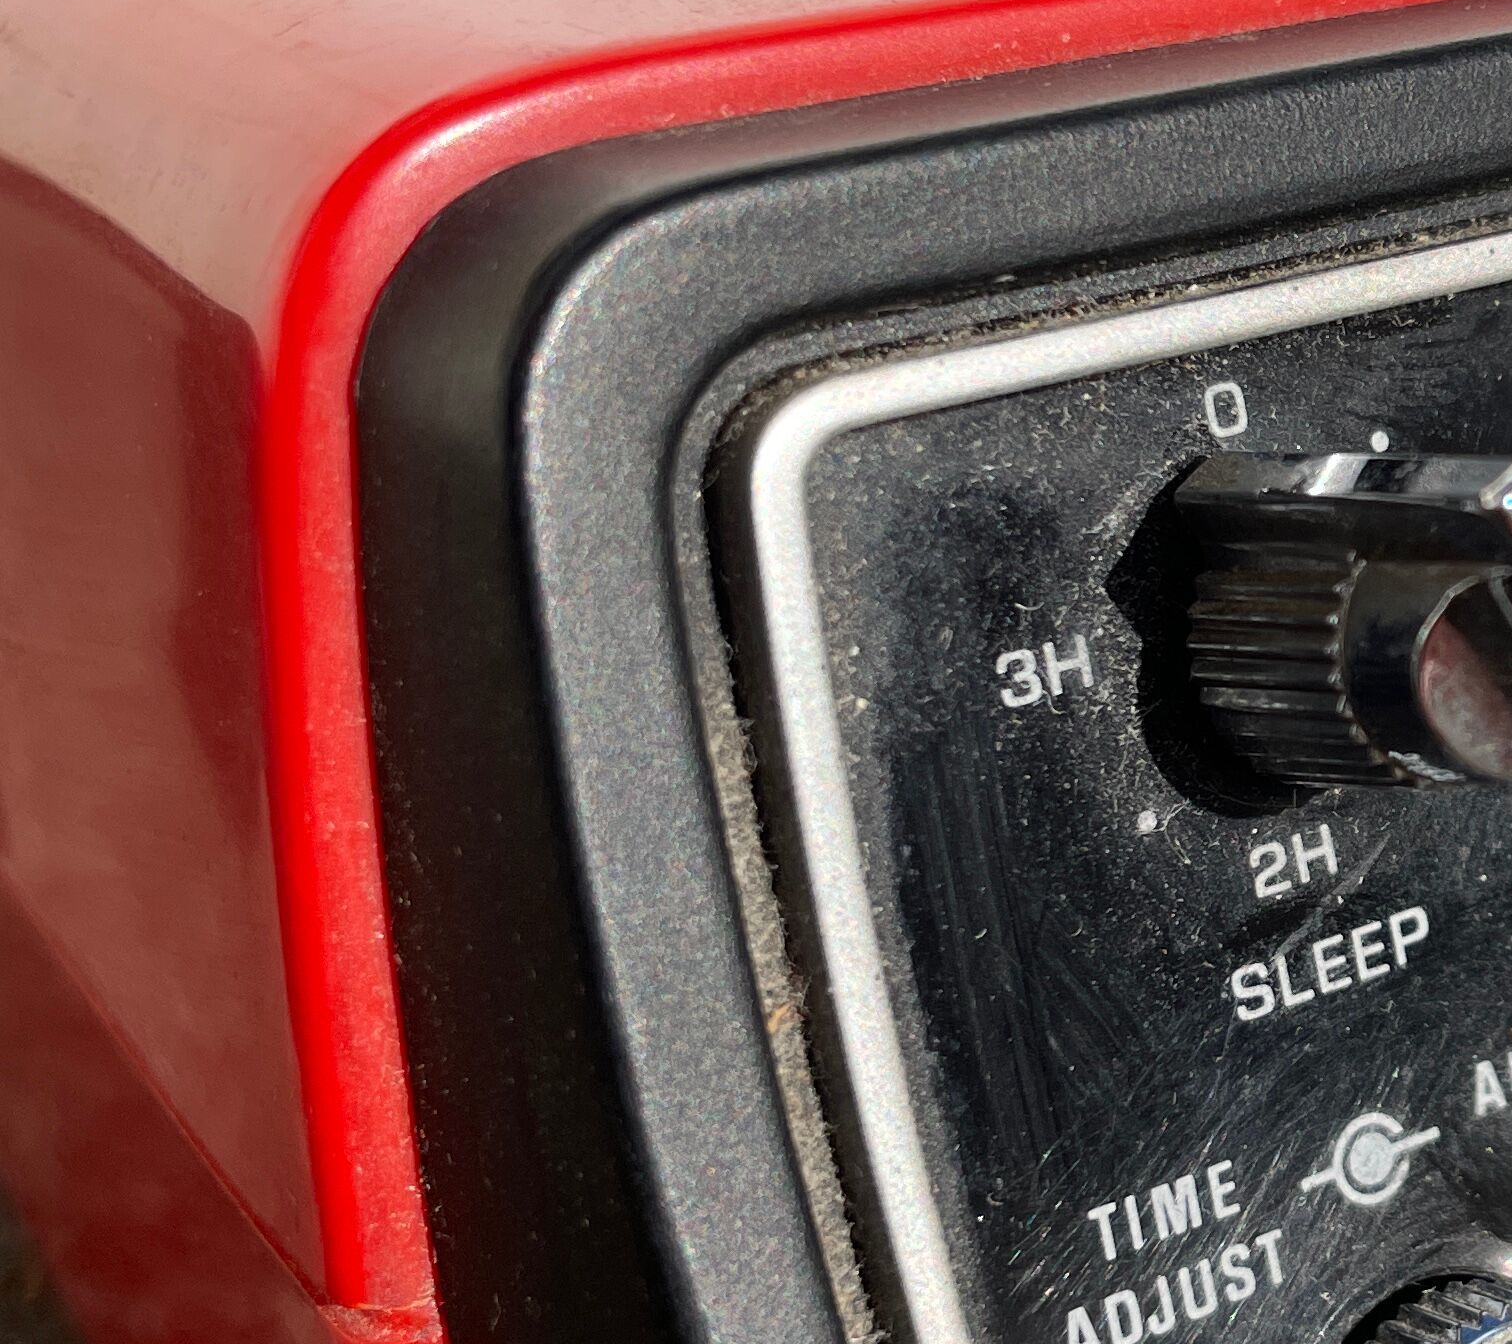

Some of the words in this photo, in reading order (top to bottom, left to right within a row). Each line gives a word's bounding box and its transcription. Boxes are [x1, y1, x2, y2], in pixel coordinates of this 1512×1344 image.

[995, 634, 1093, 708] 3H
[1249, 824, 1338, 897] 2H
[1230, 906, 1430, 1021] SLEEP
[1087, 1159, 1240, 1260] TIME
